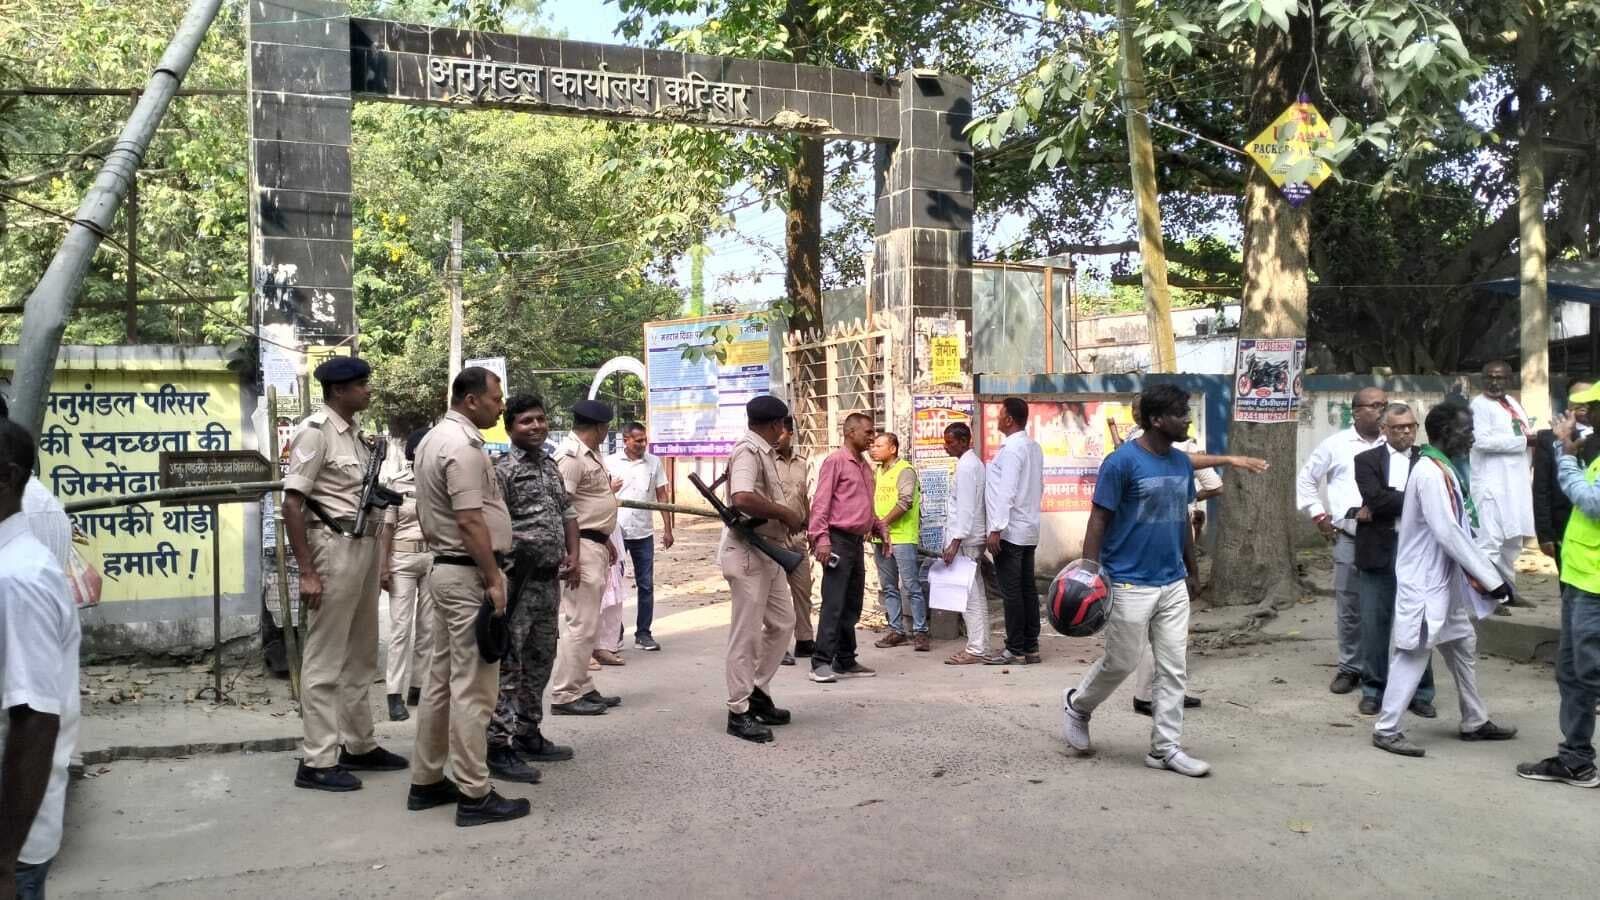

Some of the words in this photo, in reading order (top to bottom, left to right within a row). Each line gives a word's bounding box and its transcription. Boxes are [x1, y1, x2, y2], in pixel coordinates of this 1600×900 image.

[429, 54, 544, 93] अनुमंडल
[550, 62, 652, 102] कार्यालय
[663, 71, 752, 114] कटिहार
[140, 383, 210, 416] परिसर
[40, 424, 73, 457] की
[80, 431, 191, 458] स्वच्छता
[196, 422, 232, 452] की
[50, 462, 160, 496] जिम्मेंदा
[103, 541, 181, 583] हमारी
